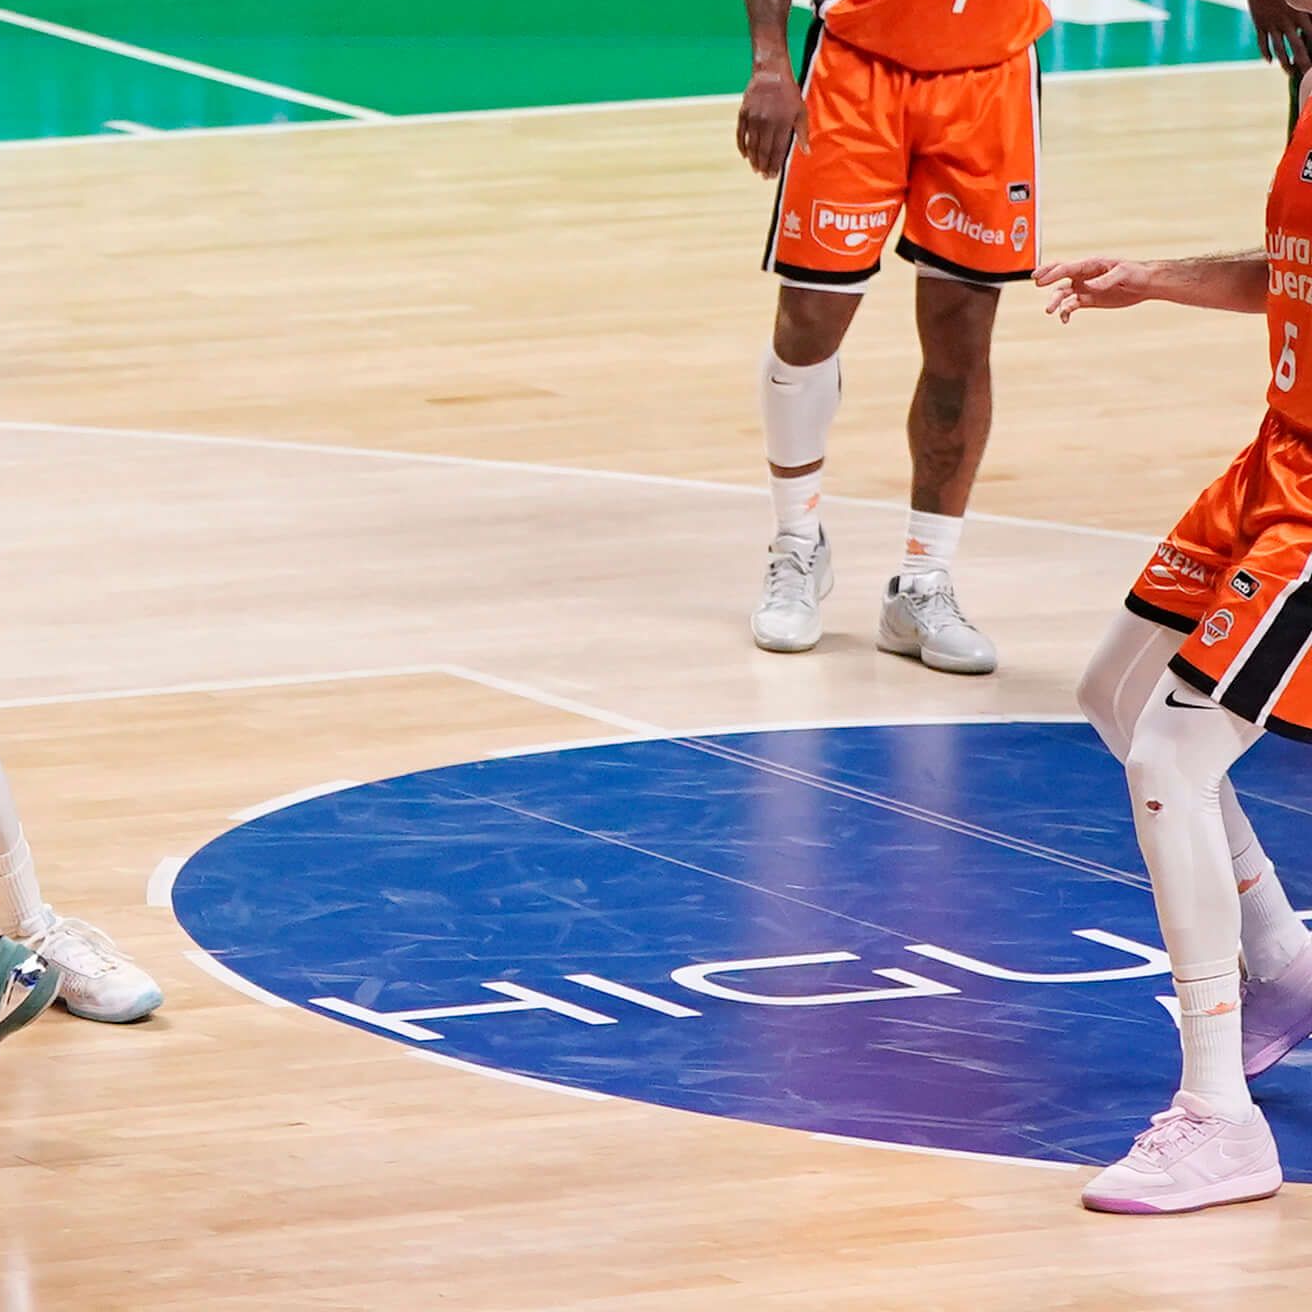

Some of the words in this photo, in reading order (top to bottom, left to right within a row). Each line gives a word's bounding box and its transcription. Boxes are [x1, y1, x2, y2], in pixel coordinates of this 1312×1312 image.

[819, 209, 888, 231] PULEVA
[926, 193, 1005, 245] Midea
[1274, 321, 1299, 393] 6
[1156, 542, 1206, 583] ULEVA
[1232, 577, 1251, 594] acb
[308, 927, 1179, 1042] HIGU
